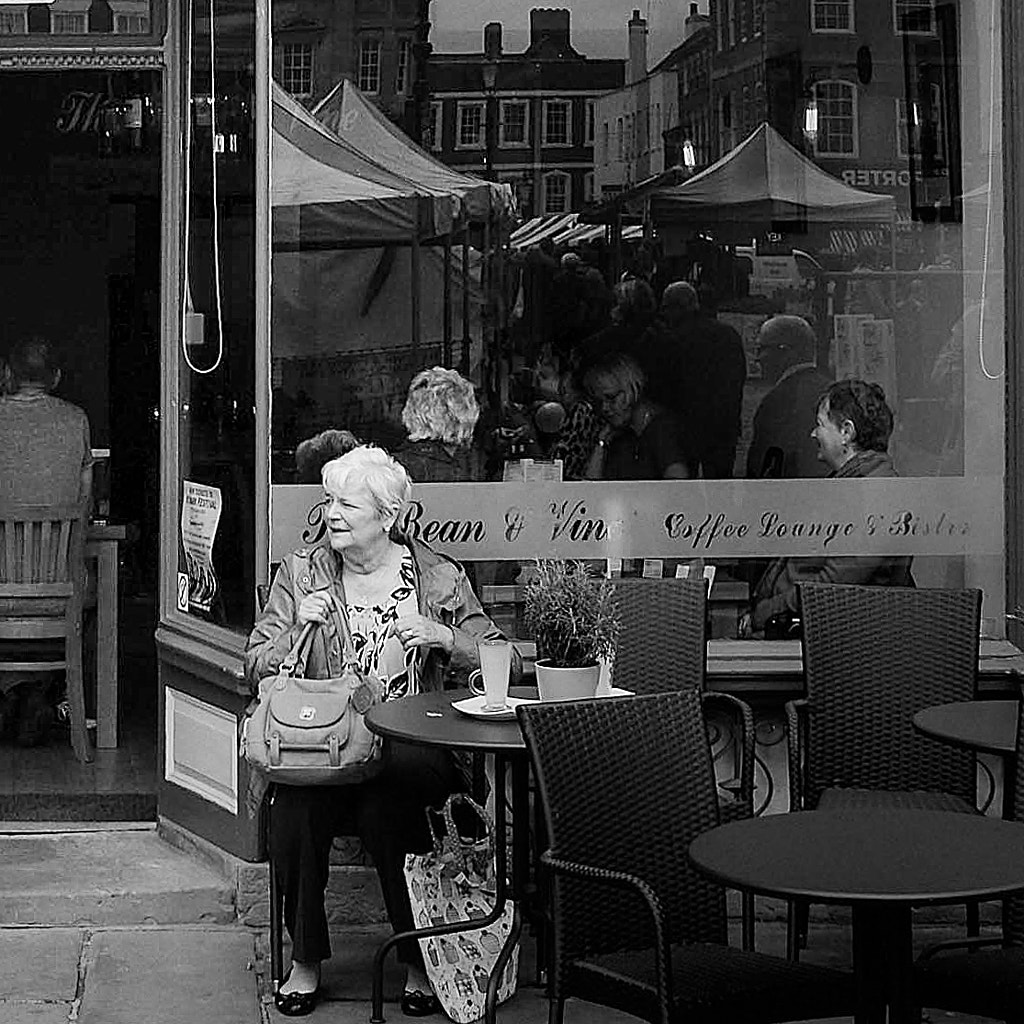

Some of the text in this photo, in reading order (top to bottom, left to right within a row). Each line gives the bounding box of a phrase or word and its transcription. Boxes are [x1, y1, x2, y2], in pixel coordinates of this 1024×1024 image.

[391, 499, 488, 544] Bean
[548, 498, 609, 543] Vin
[664, 511, 749, 550] Coffee
[759, 511, 854, 548] Lounge
